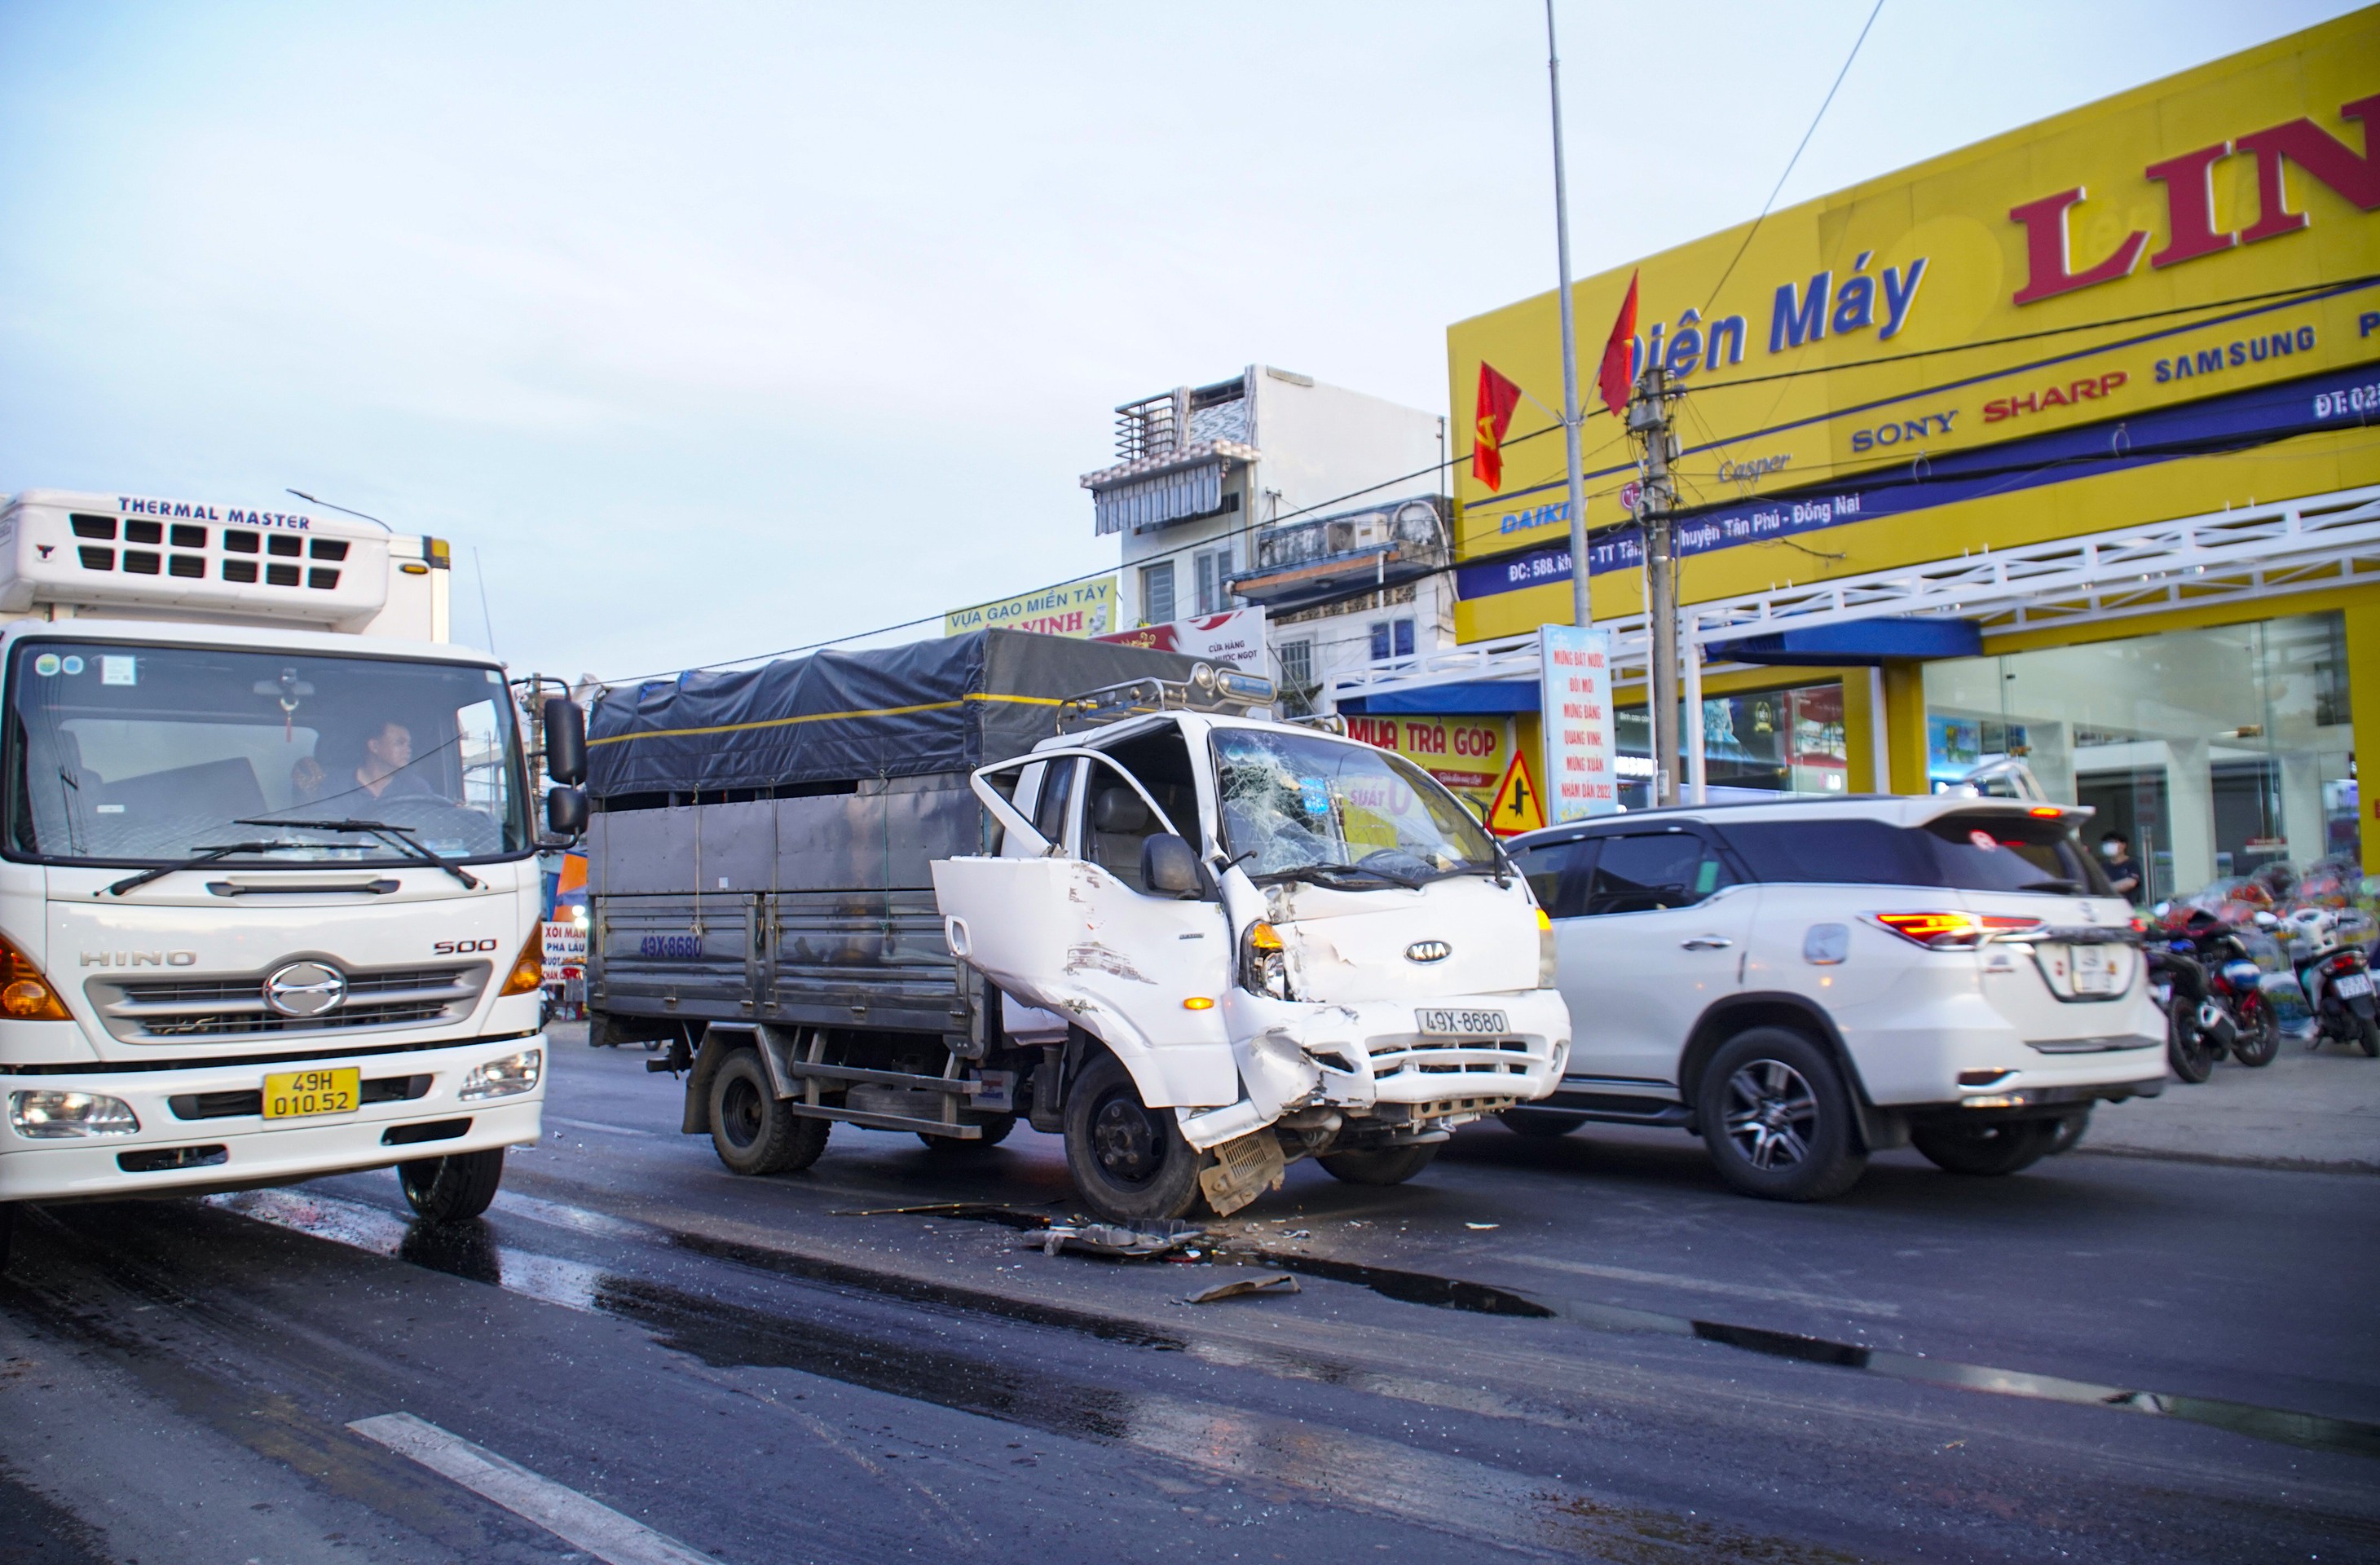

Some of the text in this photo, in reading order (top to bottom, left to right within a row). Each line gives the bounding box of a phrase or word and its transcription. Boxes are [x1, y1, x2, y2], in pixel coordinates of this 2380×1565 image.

[1769, 249, 1928, 353] Máy
[2155, 326, 2316, 383] SAMSUNG
[1983, 372, 2129, 423] SHARP
[1852, 410, 1959, 452] SONY
[1717, 453, 1792, 484] Casper
[119, 496, 310, 530] THERMAL MASTER
[1501, 500, 1587, 535] DAIKI
[1598, 544, 1615, 563] TT
[1681, 524, 1720, 549] huyện
[1724, 516, 1750, 537] Tân
[1754, 509, 1780, 533] Phú
[1793, 500, 1831, 524] Đồng
[1836, 492, 1860, 515] Nai
[951, 611, 981, 628] VỰA
[987, 602, 1021, 621] GẠO
[1027, 589, 1068, 612] MIỀN
[1074, 584, 1108, 603] TÂY
[1224, 639, 1245, 650] HÀNG
[1238, 650, 1258, 660] NGỌT
[1347, 716, 1496, 757] MUA TRẢ GÓP
[1564, 730, 1585, 747] QUANG
[1597, 783, 1611, 799] 2022
[79, 950, 197, 967] HINO
[434, 939, 497, 955] 500
[1412, 942, 1447, 959] KIA
[1426, 1011, 1505, 1033] 49X-8680
[293, 1072, 333, 1092] 49H
[275, 1091, 348, 1115] 010.52
